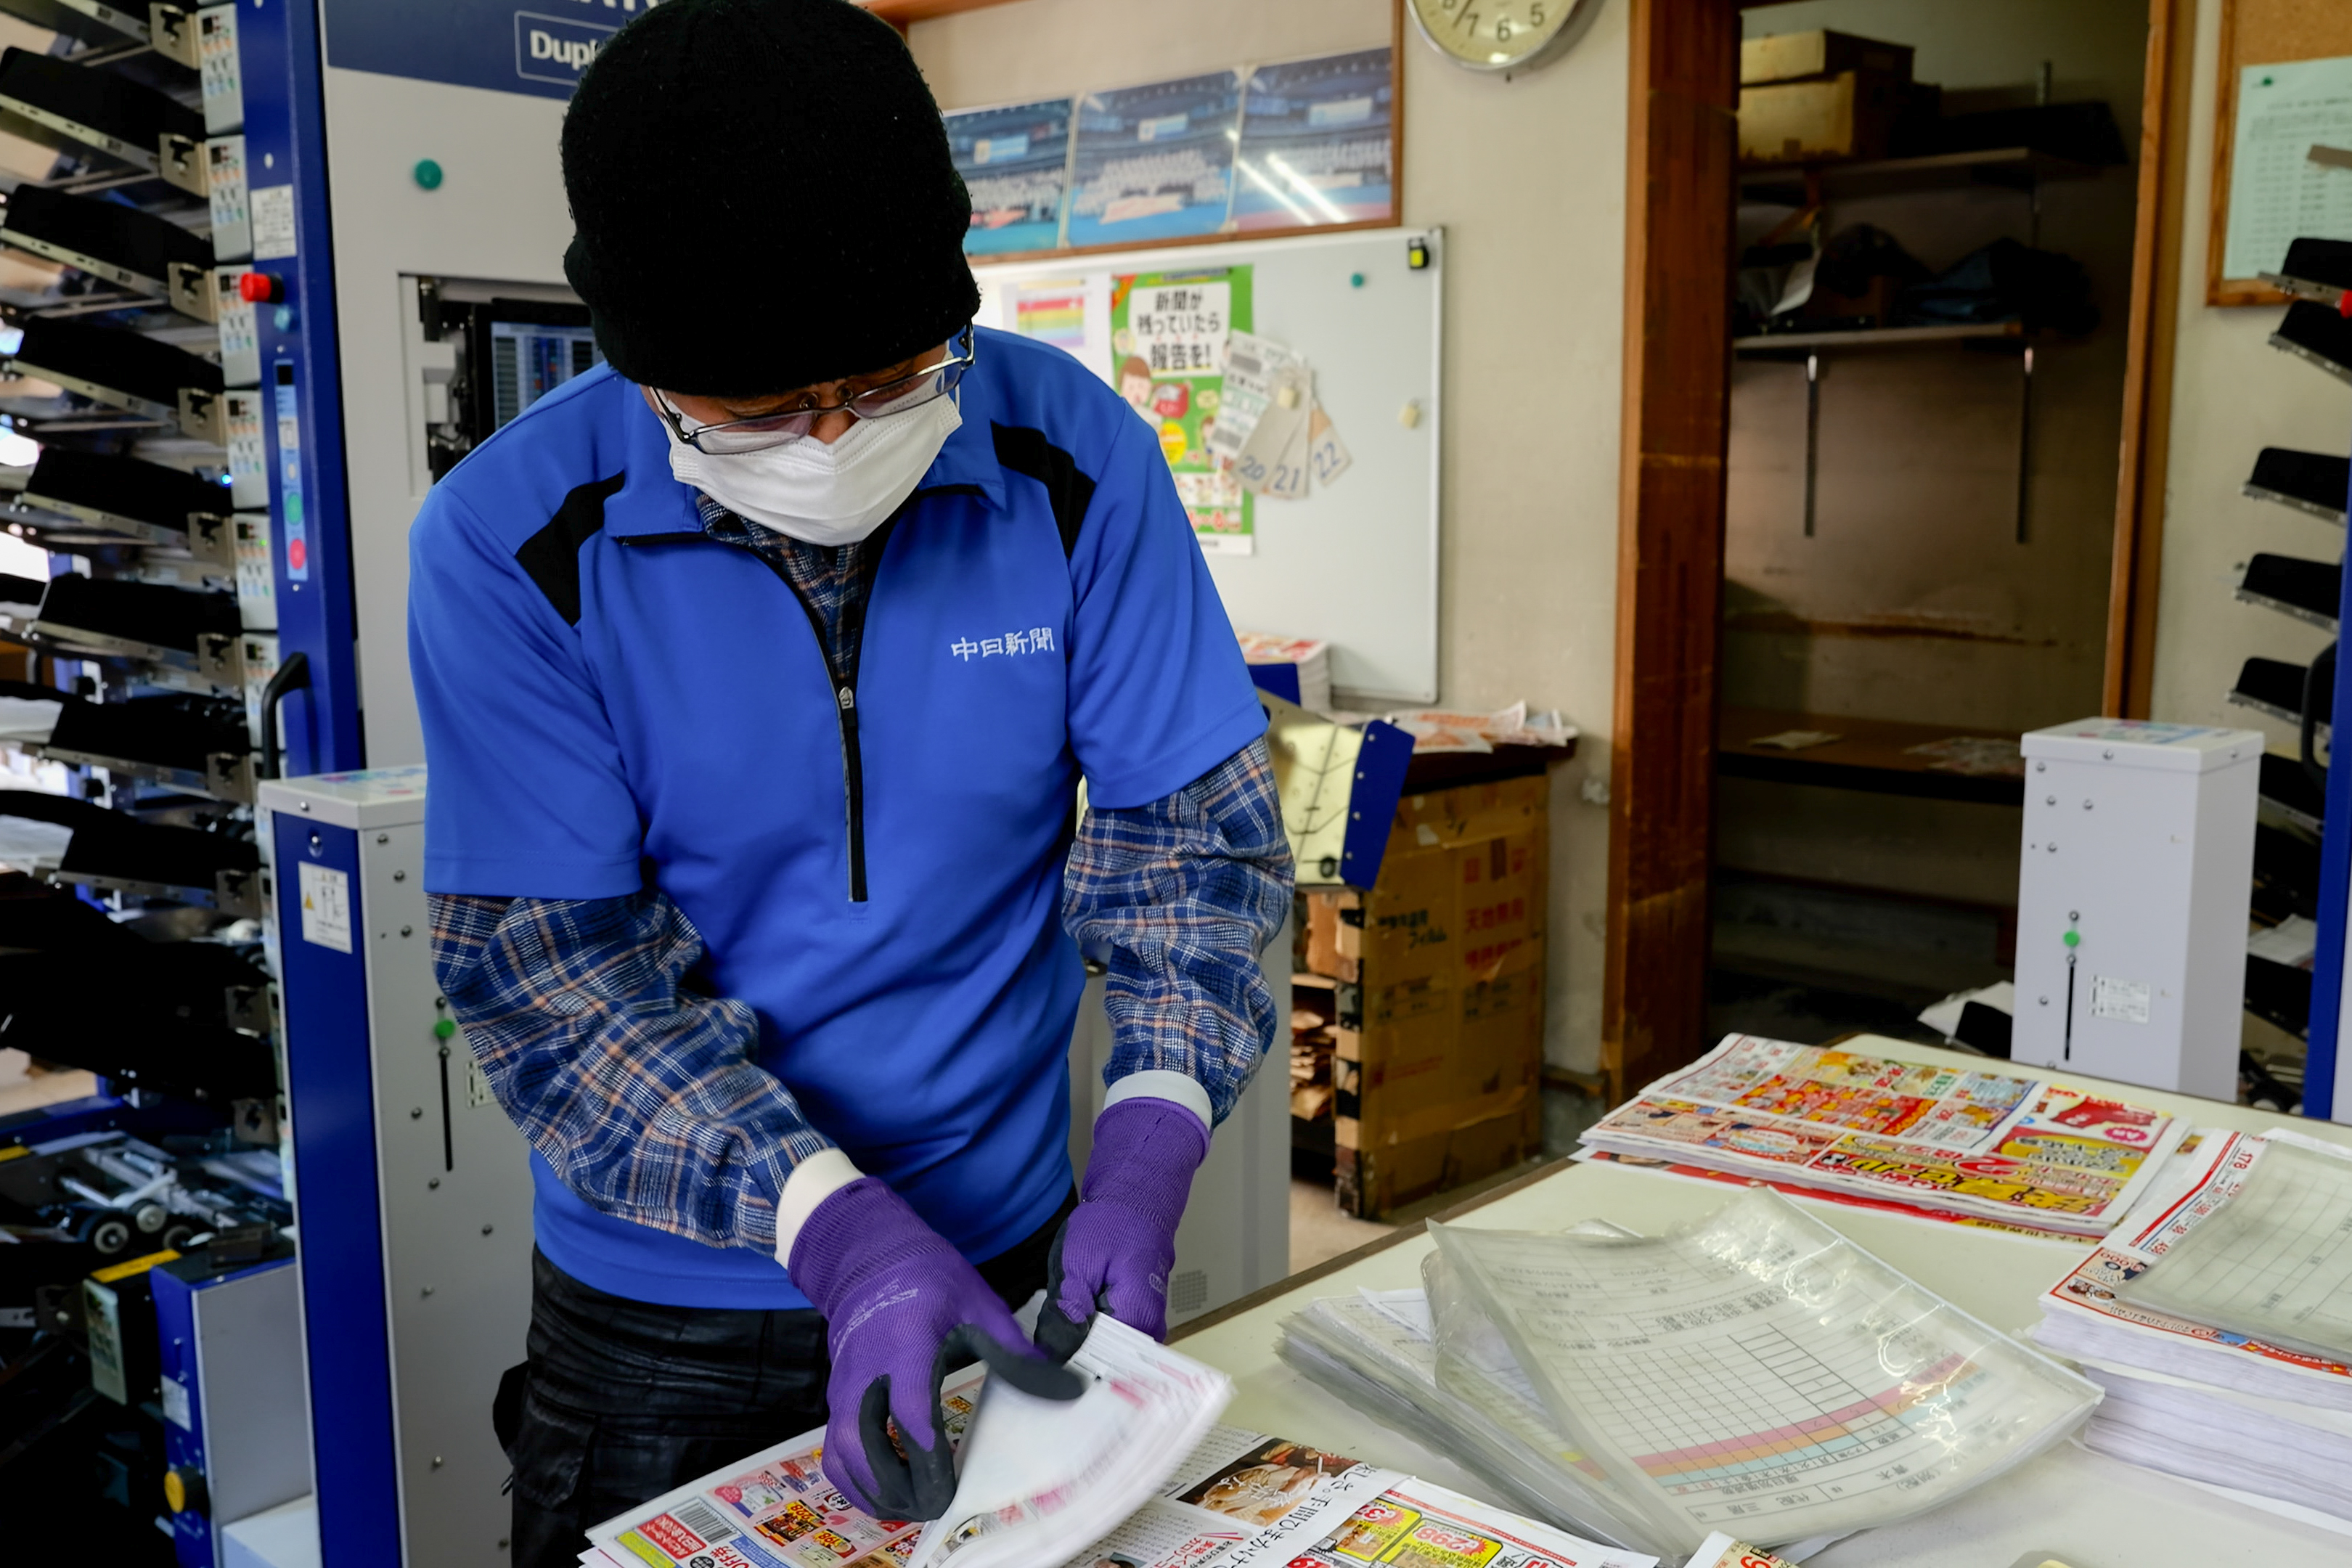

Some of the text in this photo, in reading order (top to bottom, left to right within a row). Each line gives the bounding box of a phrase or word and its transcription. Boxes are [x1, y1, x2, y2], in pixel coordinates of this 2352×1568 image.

[1466, 12, 1479, 37] 7
[1530, 2, 1545, 27] 5
[1497, 18, 1511, 42] 6
[1240, 455, 1267, 482] 20
[1313, 441, 1342, 479] 22
[1274, 465, 1302, 492] 21
[950, 626, 1055, 662] 中日新聞
[790, 1503, 812, 1521] 228
[819, 1530, 841, 1546] 198
[1415, 1525, 1468, 1549] 298
